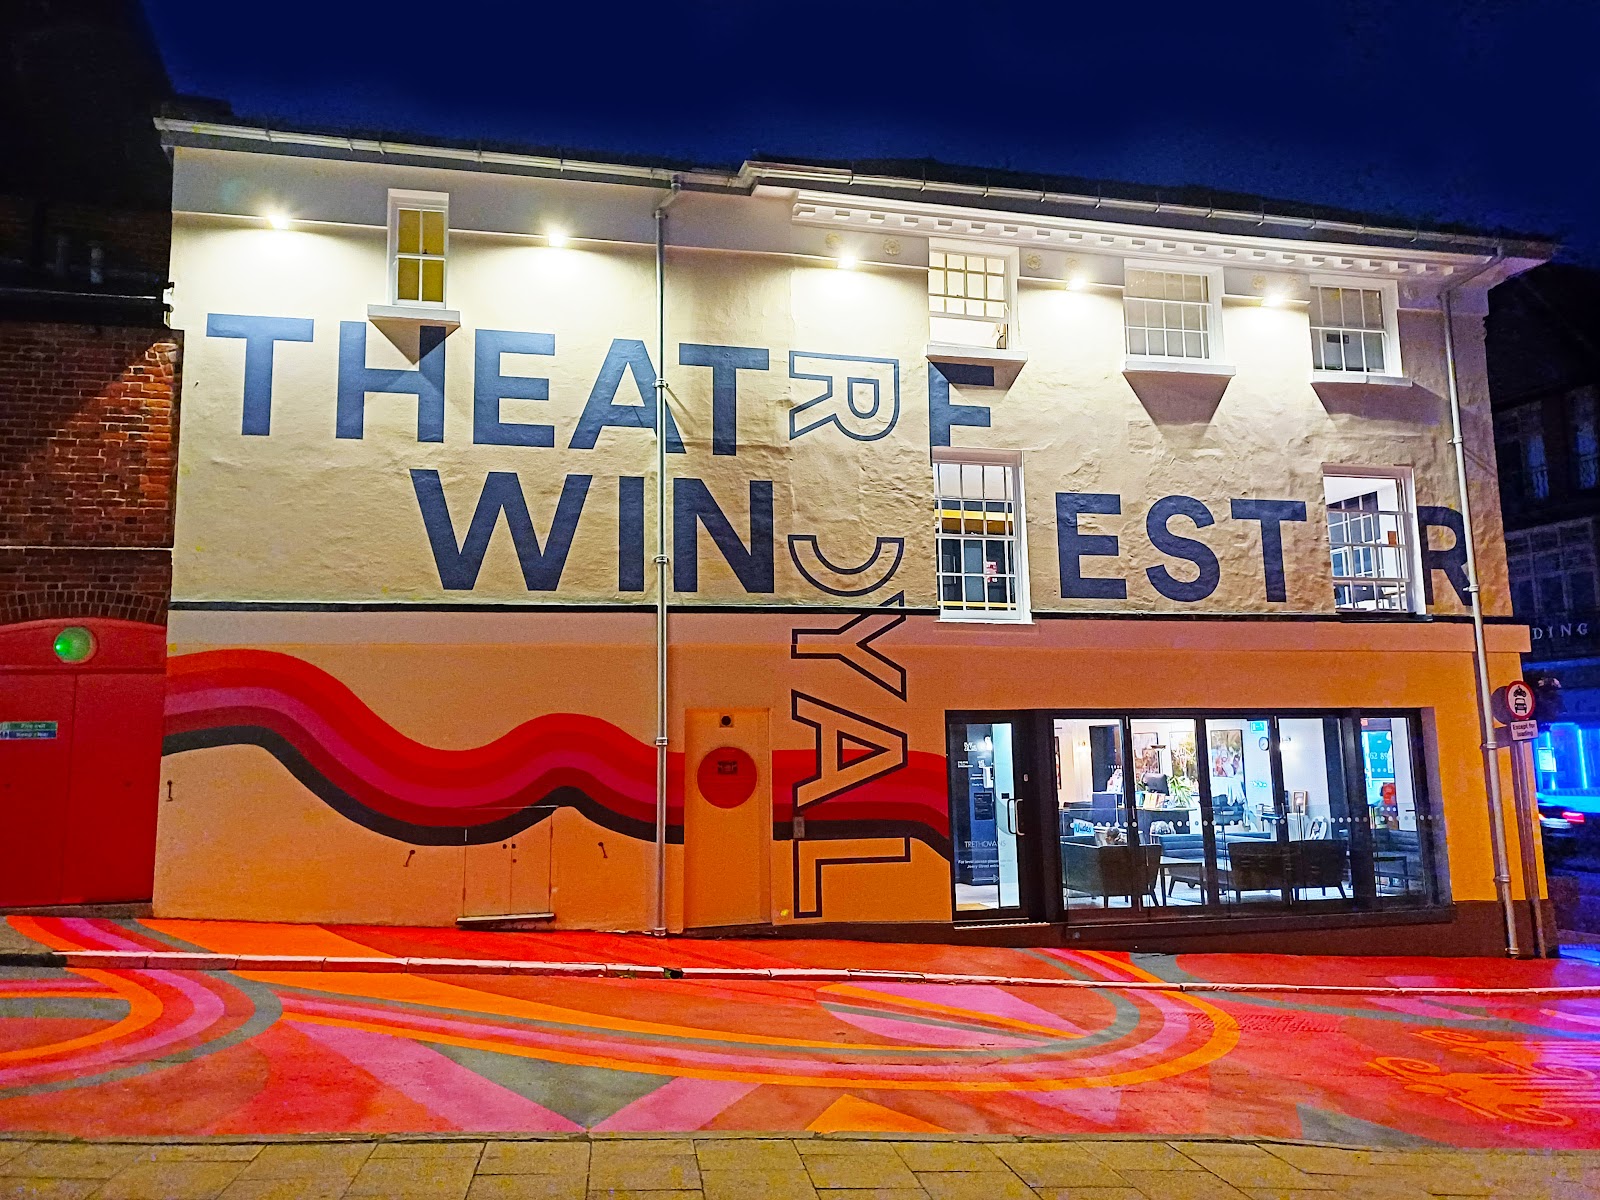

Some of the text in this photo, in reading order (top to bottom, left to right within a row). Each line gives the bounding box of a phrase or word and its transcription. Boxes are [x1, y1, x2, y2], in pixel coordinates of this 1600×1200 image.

[1532, 623, 1588, 640] DING
[1512, 723, 1528, 731] Except
[1516, 730, 1534, 738] loading
